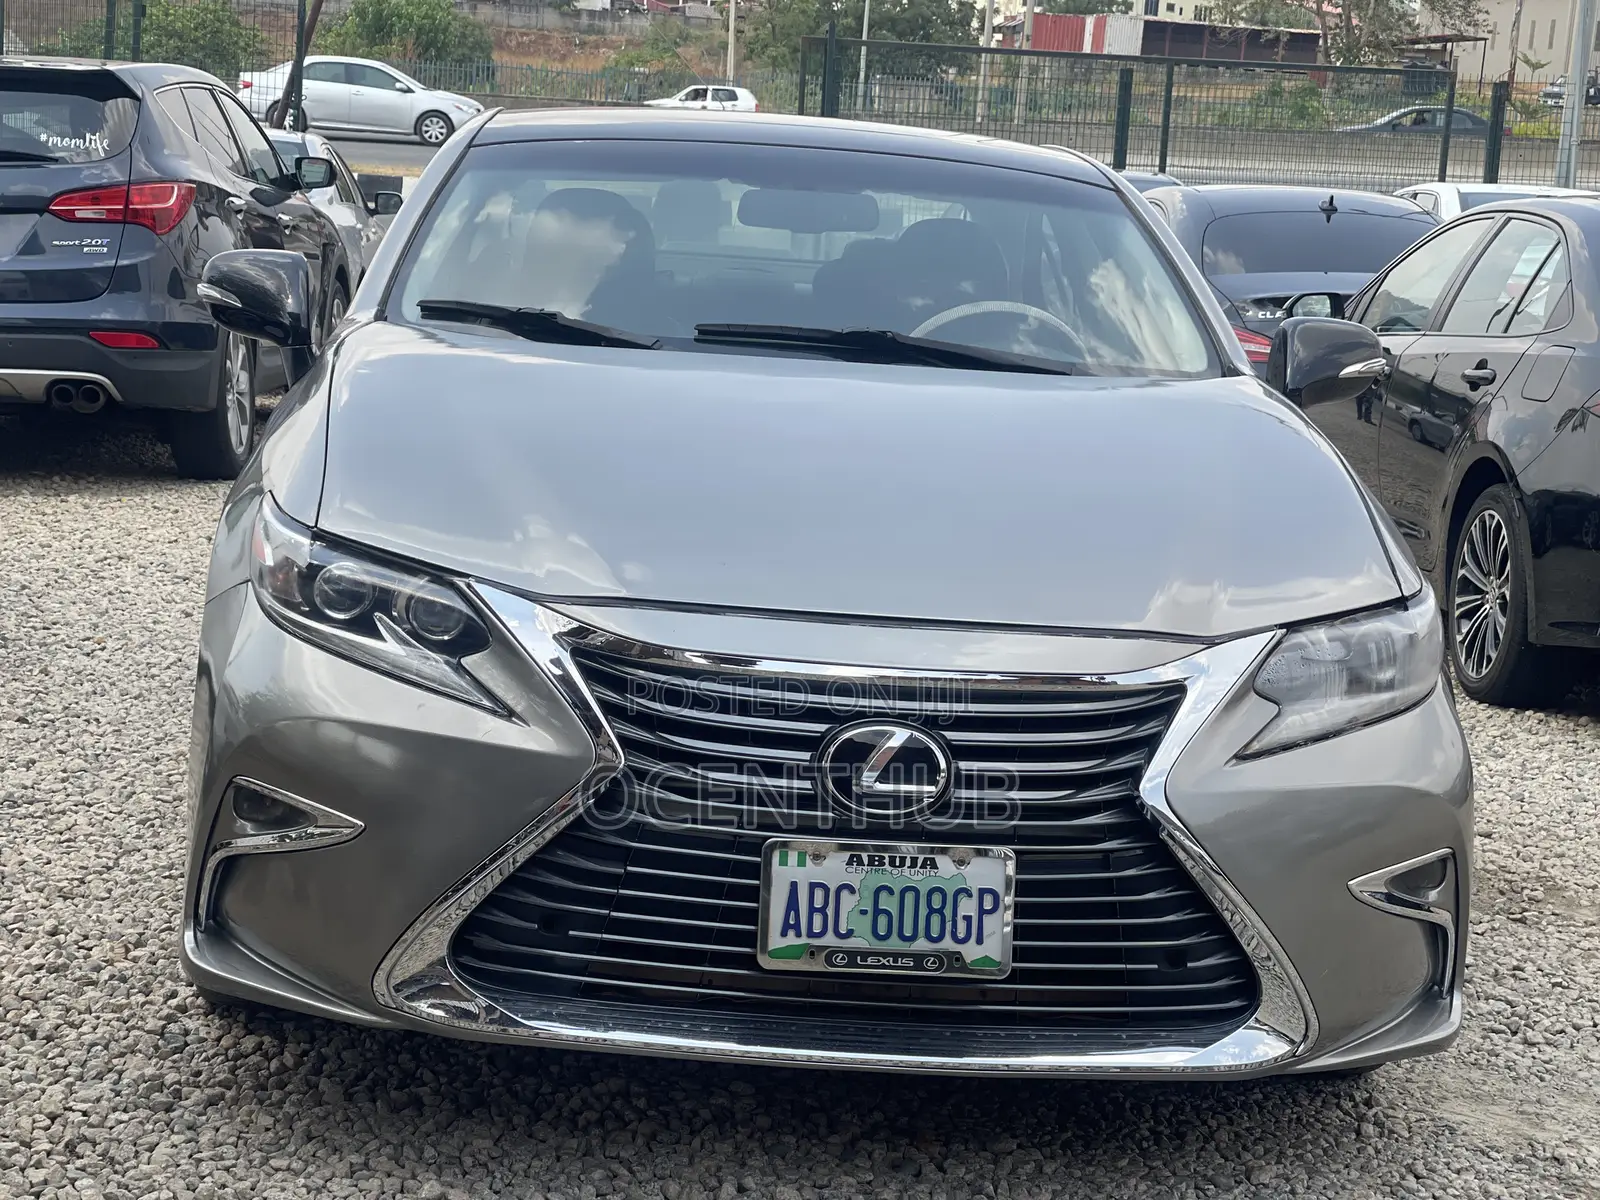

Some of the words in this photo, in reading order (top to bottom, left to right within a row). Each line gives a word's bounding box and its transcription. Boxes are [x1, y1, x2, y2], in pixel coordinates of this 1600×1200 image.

[40, 132, 110, 157] #momlife
[845, 853, 939, 870] ABUJA
[845, 866, 887, 876] CENTRE
[890, 868, 906, 877] OF
[909, 869, 940, 879] UNITY
[780, 880, 1000, 945] ABC-608GP
[857, 955, 914, 967] LEXUS
